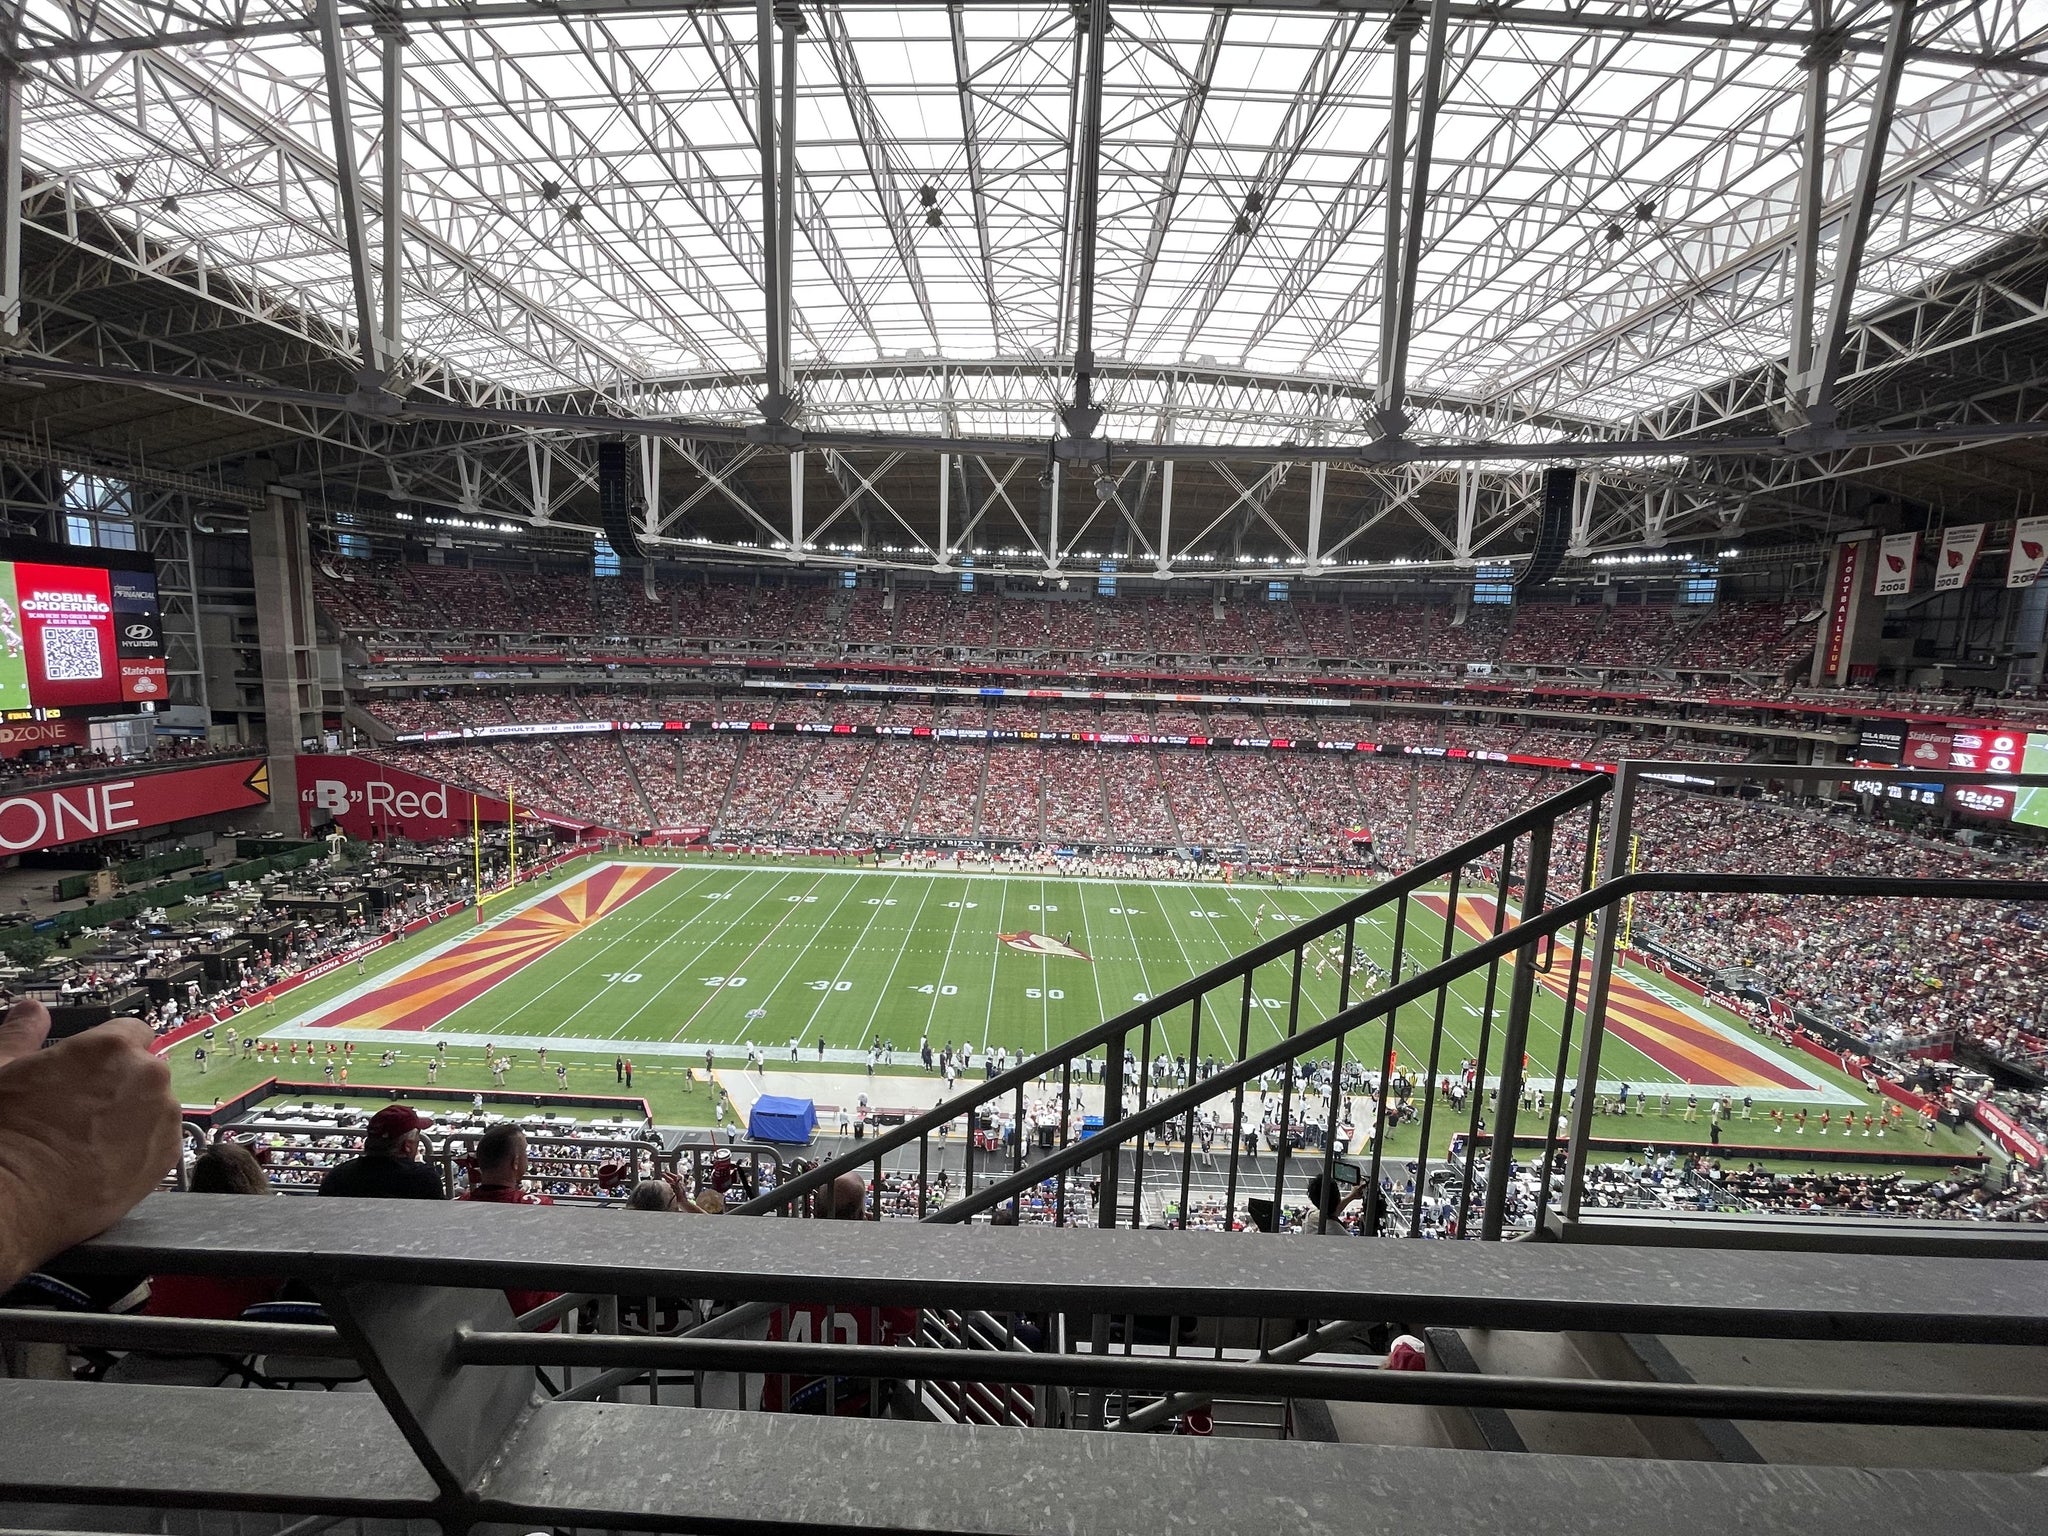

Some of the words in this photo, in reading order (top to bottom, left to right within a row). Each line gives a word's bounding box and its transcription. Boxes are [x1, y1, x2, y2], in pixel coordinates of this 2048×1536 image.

[1836, 555, 1853, 633] FOOTBALL
[1880, 583, 1906, 592] 2008
[33, 591, 98, 604] MOBILE
[21, 600, 110, 613] ORDERING
[121, 640, 158, 648] HYUNDAI
[1829, 635, 1842, 672] CLUB
[121, 666, 144, 676] State
[144, 666, 165, 675] Farm
[1020, 731, 1038, 739] 12:42
[1862, 732, 1878, 740] GILA
[1878, 733, 1901, 742] RIVER
[1908, 731, 1930, 741] State
[1930, 733, 1951, 744] Farm
[1994, 737, 2014, 751] 0
[1990, 756, 2010, 769] 0
[1853, 780, 1883, 796] 12:42
[1956, 789, 2004, 808] 12:42
[303, 959, 340, 981] ARIZONA
[342, 939, 383, 961] CARDINALS
[1646, 942, 1671, 958] ARIZONA
[1671, 954, 1702, 973] CARDINALS
[607, 972, 643, 983] 10
[705, 976, 748, 988] 20
[811, 980, 853, 991] 30
[917, 984, 959, 995] 40
[1025, 988, 1065, 1000] 50
